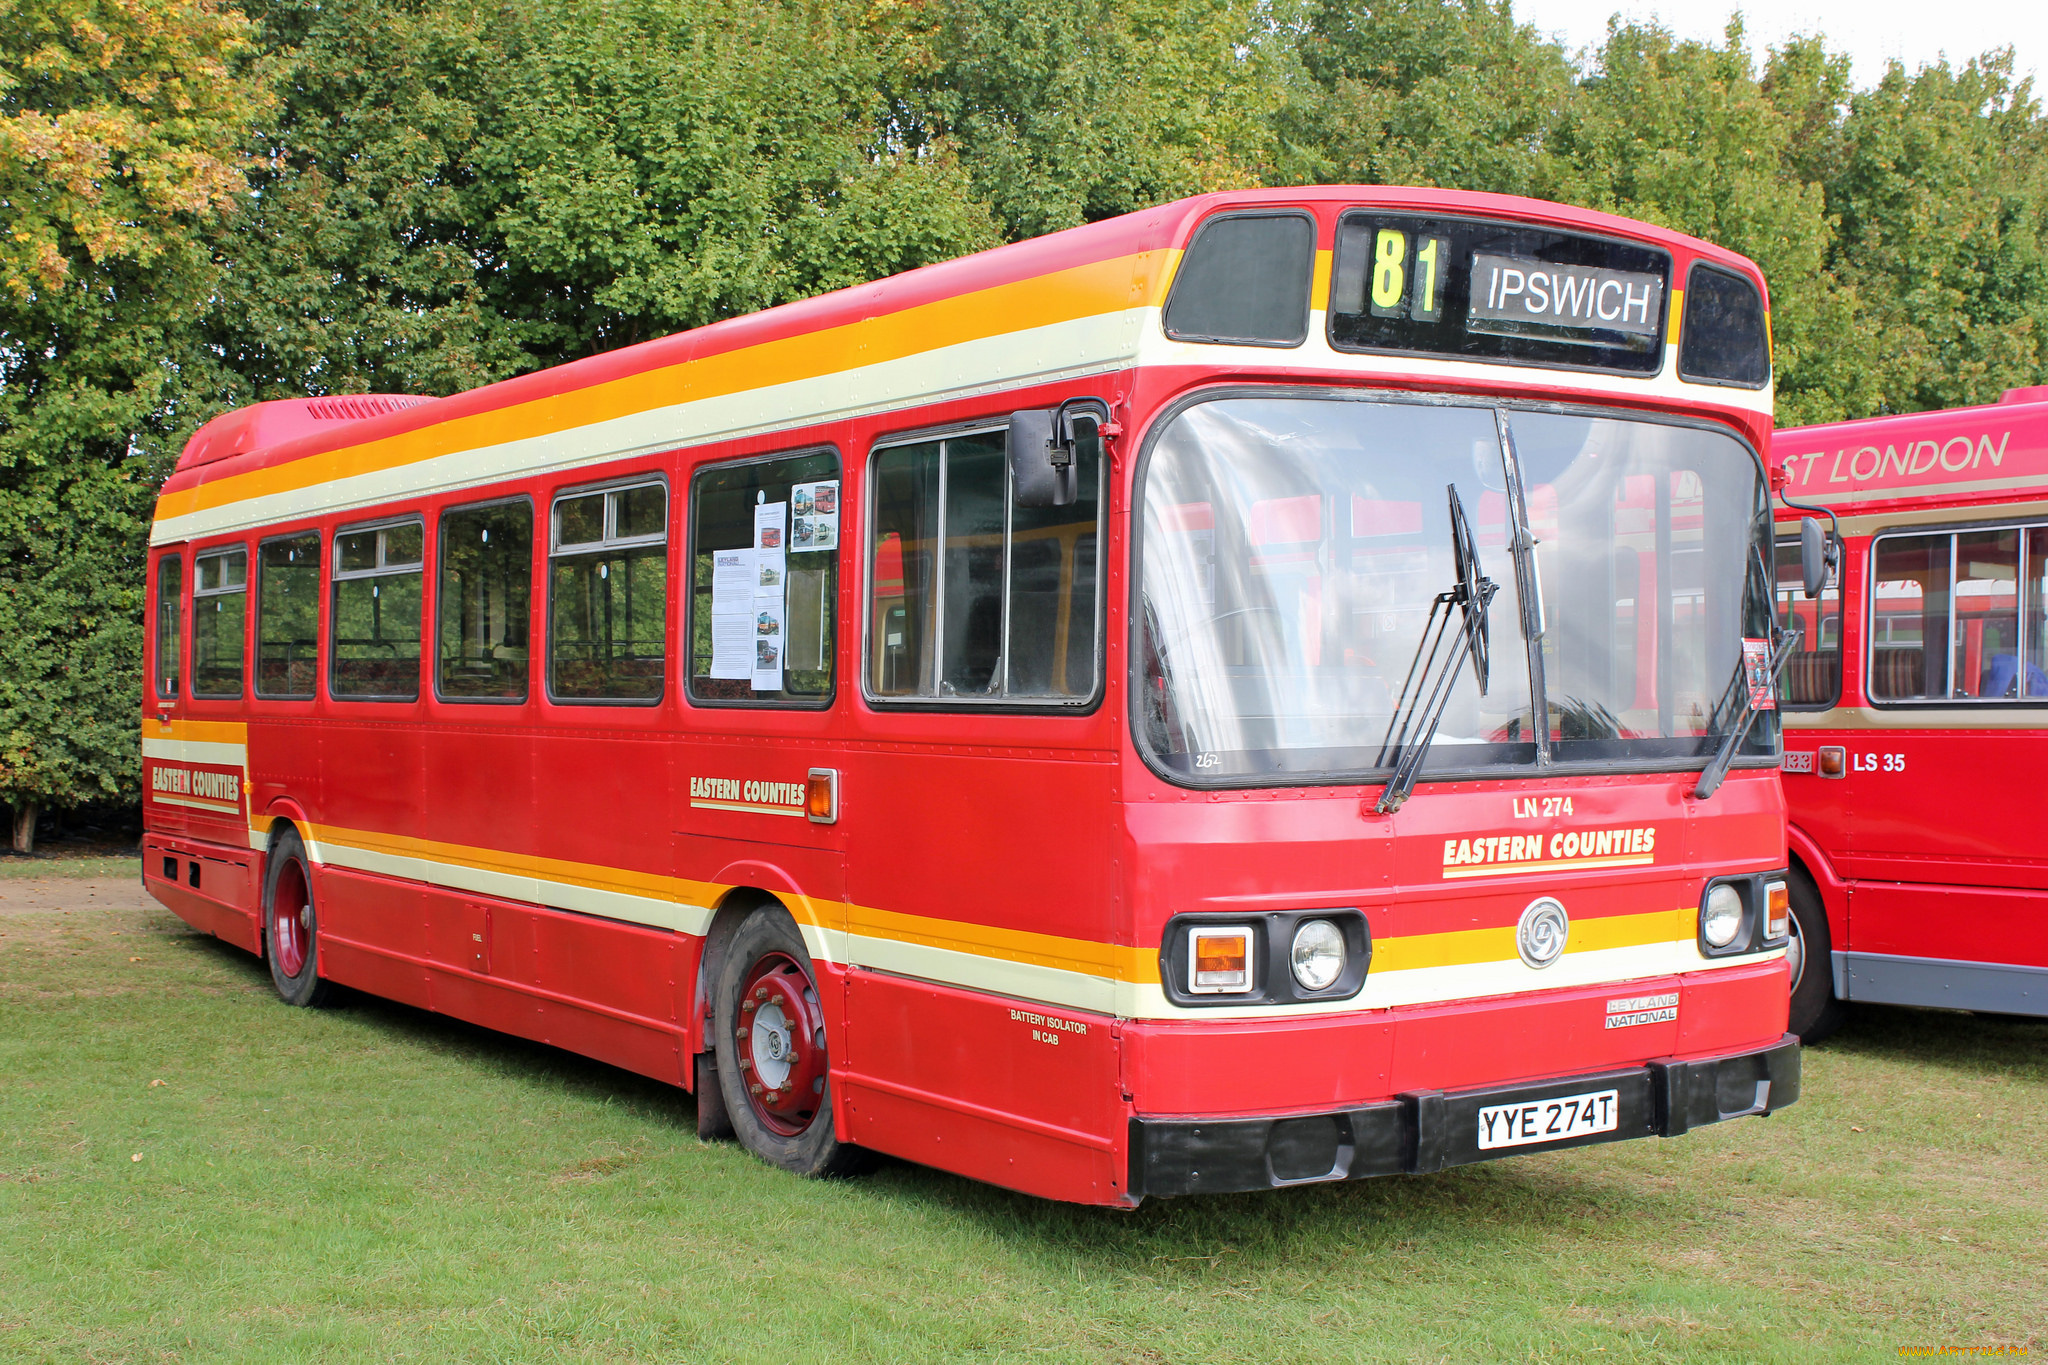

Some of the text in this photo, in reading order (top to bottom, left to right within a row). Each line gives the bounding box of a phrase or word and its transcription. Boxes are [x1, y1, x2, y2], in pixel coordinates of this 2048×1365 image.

[1371, 229, 1438, 312] 81
[1487, 267, 1651, 325] IPSWICH
[1780, 431, 2011, 487] ST LONDON
[1195, 752, 1223, 768] 262
[1853, 753, 1906, 772] LS 35
[192, 770, 239, 802] COUNTIES
[690, 776, 806, 806] EASTERN COUNTIES
[1512, 796, 1574, 818] LN 274
[1442, 827, 1656, 865] EASTERN COUNTIES
[1608, 994, 1678, 1013] LEYLAND
[1010, 1008, 1087, 1035] BATTERY ISOLATOR
[1606, 1009, 1676, 1028] NATIONAL
[1032, 1029, 1059, 1046] IN CAB
[1483, 1095, 1613, 1142] YYE 274T
